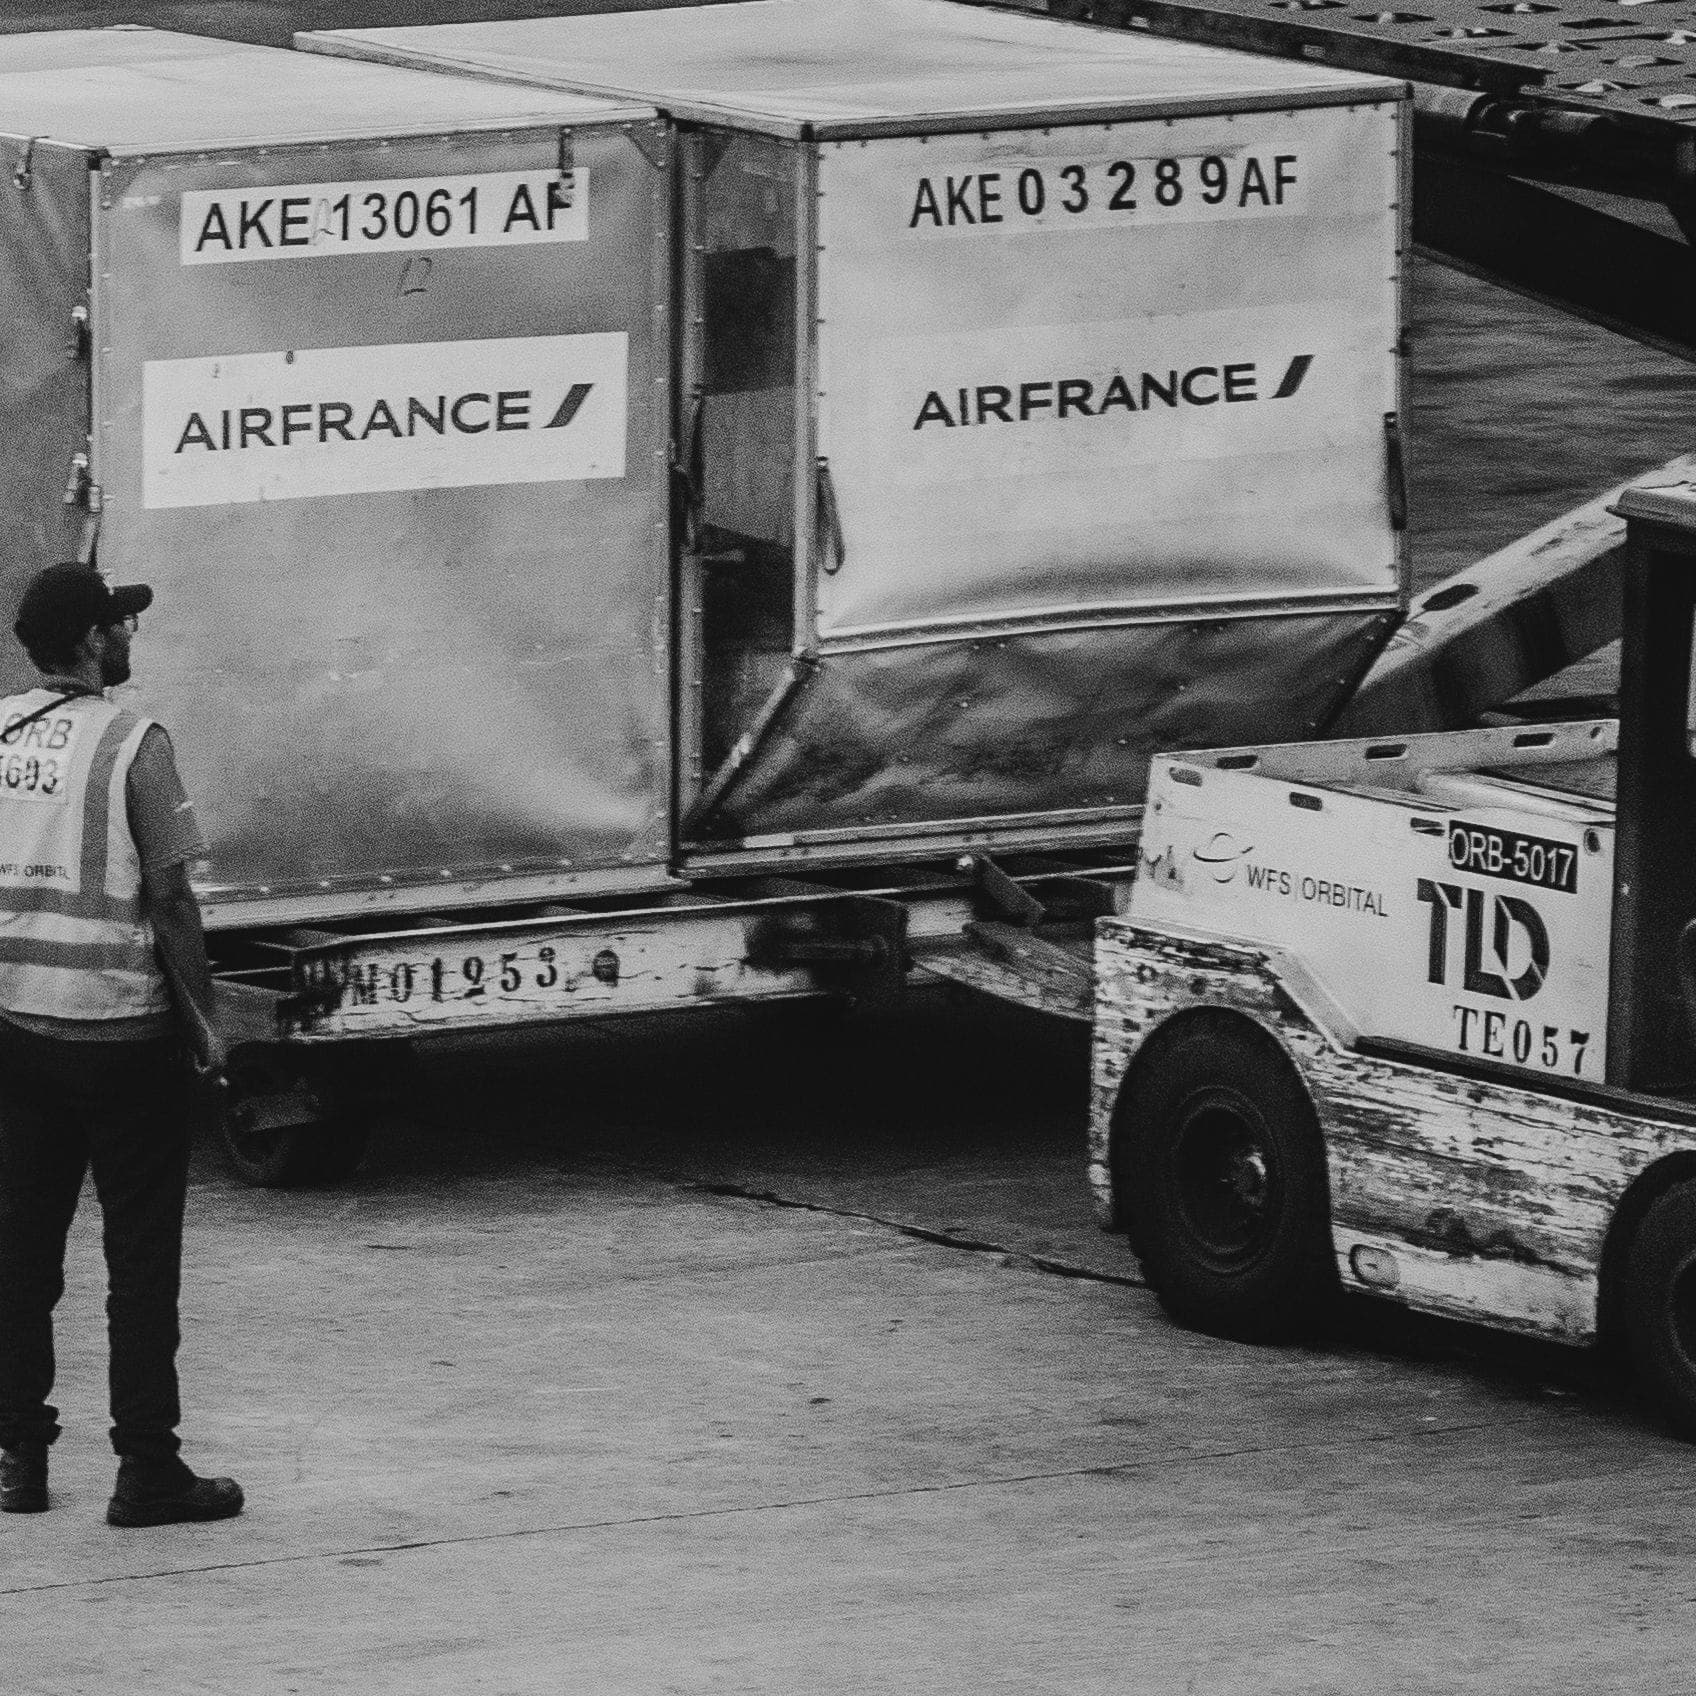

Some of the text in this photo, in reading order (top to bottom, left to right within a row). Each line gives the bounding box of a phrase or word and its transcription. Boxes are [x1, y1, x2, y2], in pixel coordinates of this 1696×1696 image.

[193, 180, 573, 253] AKE 13061 AF
[173, 389, 532, 455] AIRFRANCE
[912, 362, 1259, 431] AIRFRANCE
[1246, 864, 1390, 918] WFS ORBITAL
[1450, 826, 1575, 888] ORB-5017
[1416, 877, 1551, 1002] TLD
[1452, 1004, 1591, 1075] TE057
